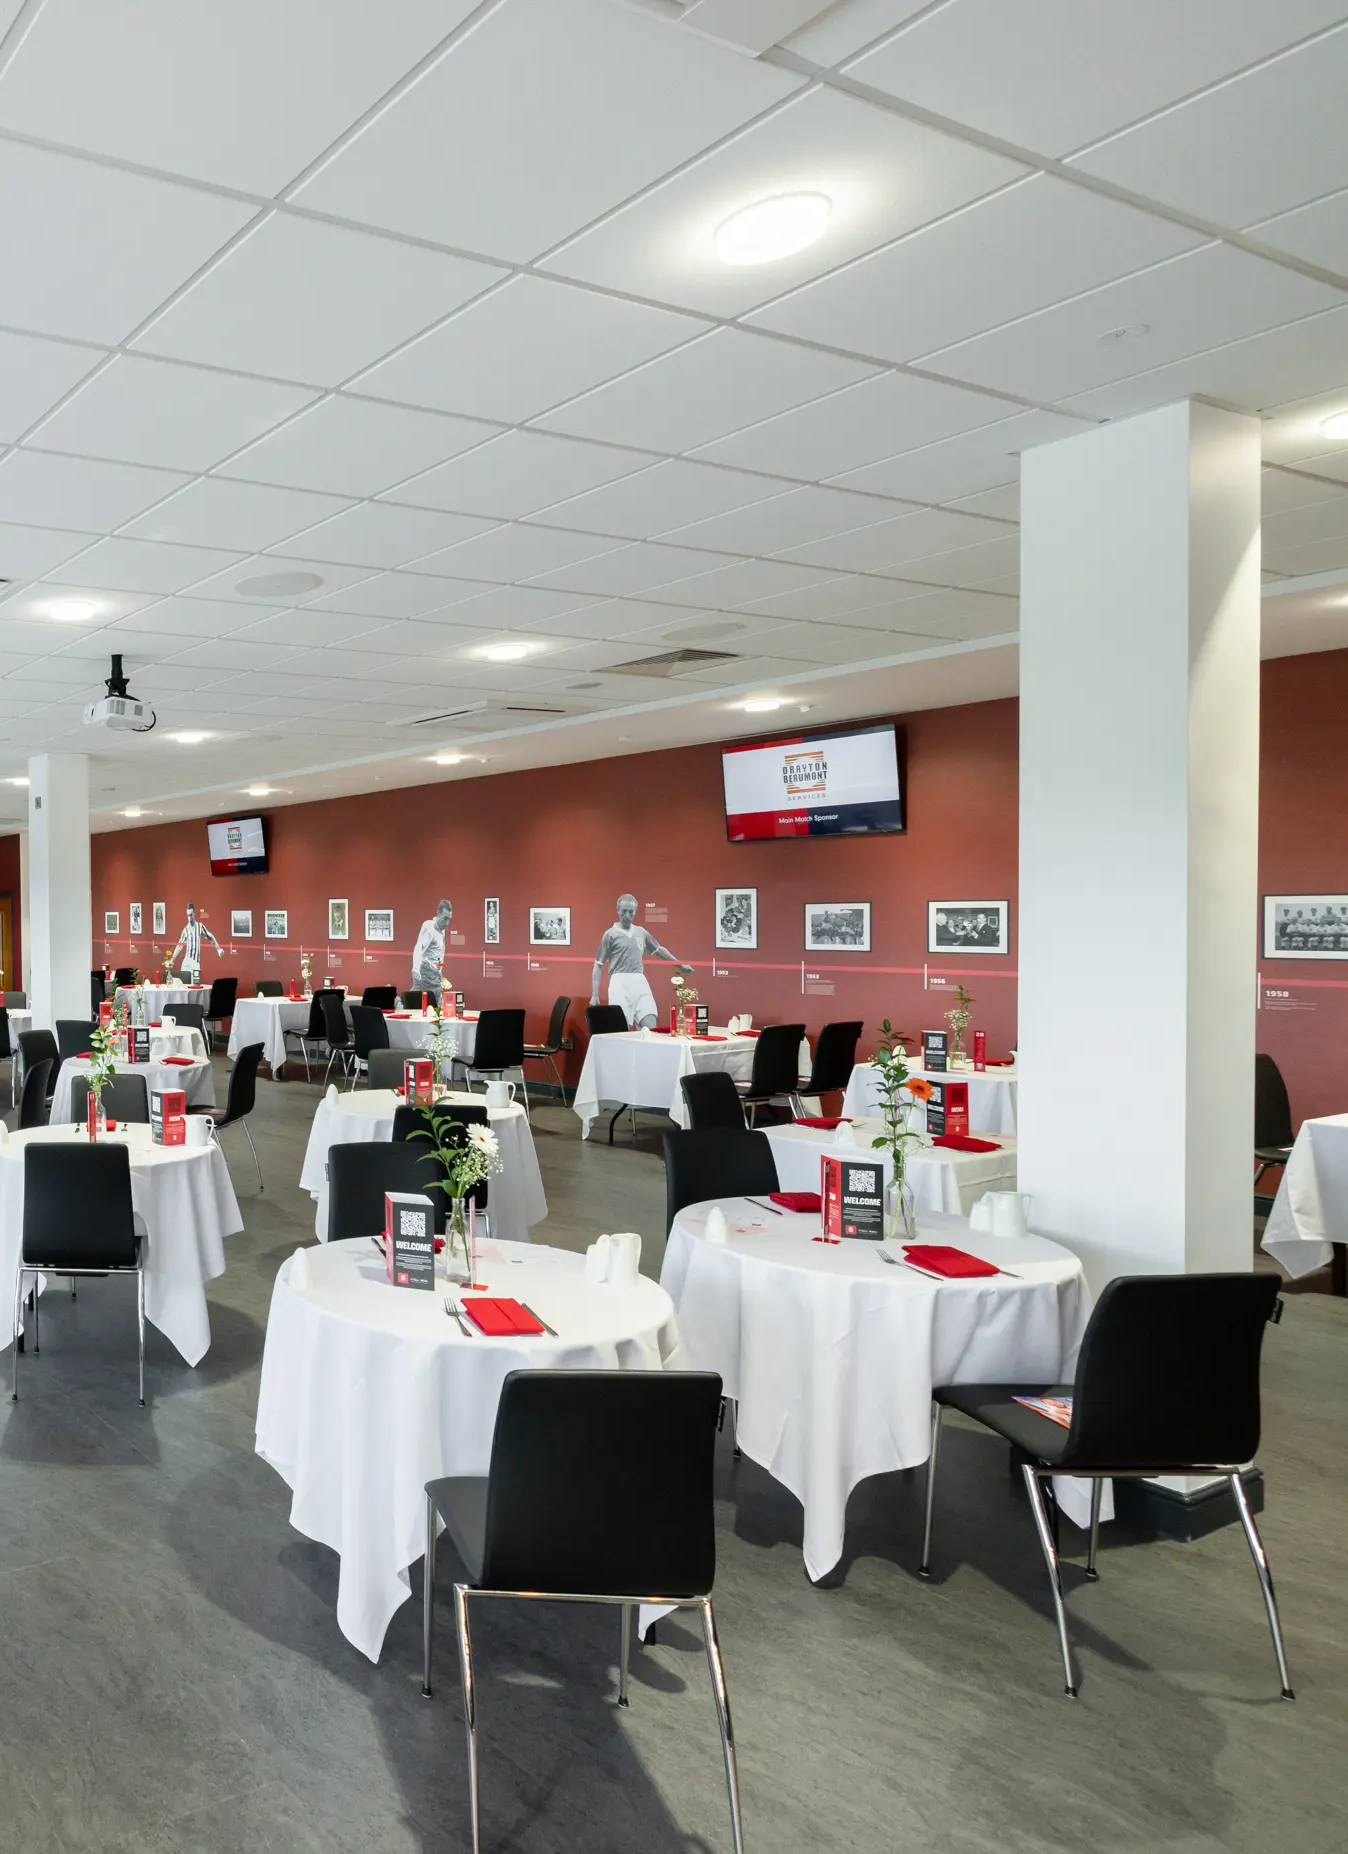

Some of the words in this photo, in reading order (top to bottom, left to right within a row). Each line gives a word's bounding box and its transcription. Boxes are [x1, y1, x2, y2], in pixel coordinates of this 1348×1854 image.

[782, 761, 828, 775] DRAYTON
[783, 770, 828, 784] BEAUMONT
[787, 793, 826, 801] SERVICES
[778, 816, 794, 824] Main
[794, 815, 813, 823] Match
[813, 813, 839, 822] Sponsor
[843, 1196, 882, 1207] WELCOME
[395, 1240, 432, 1252] WELCOME
